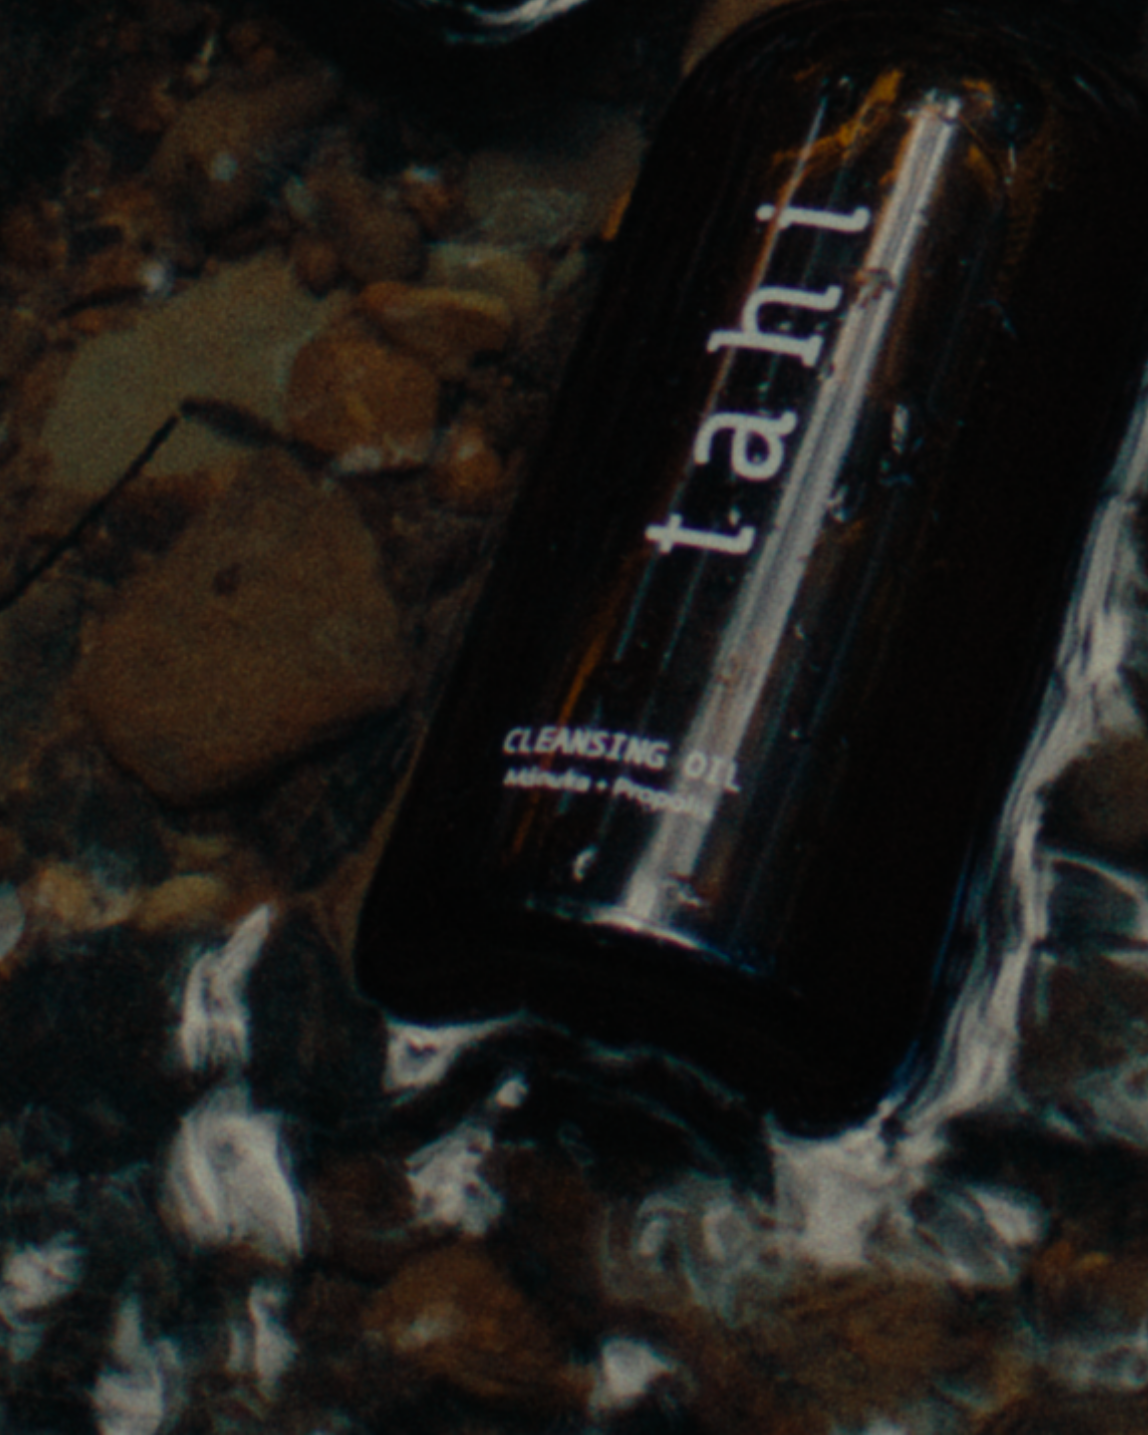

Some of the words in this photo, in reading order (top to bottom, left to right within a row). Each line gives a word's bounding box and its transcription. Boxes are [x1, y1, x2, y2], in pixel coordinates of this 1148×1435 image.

[644, 202, 871, 556] tahi
[502, 724, 669, 772] CLEANSING
[683, 749, 741, 793] OIL
